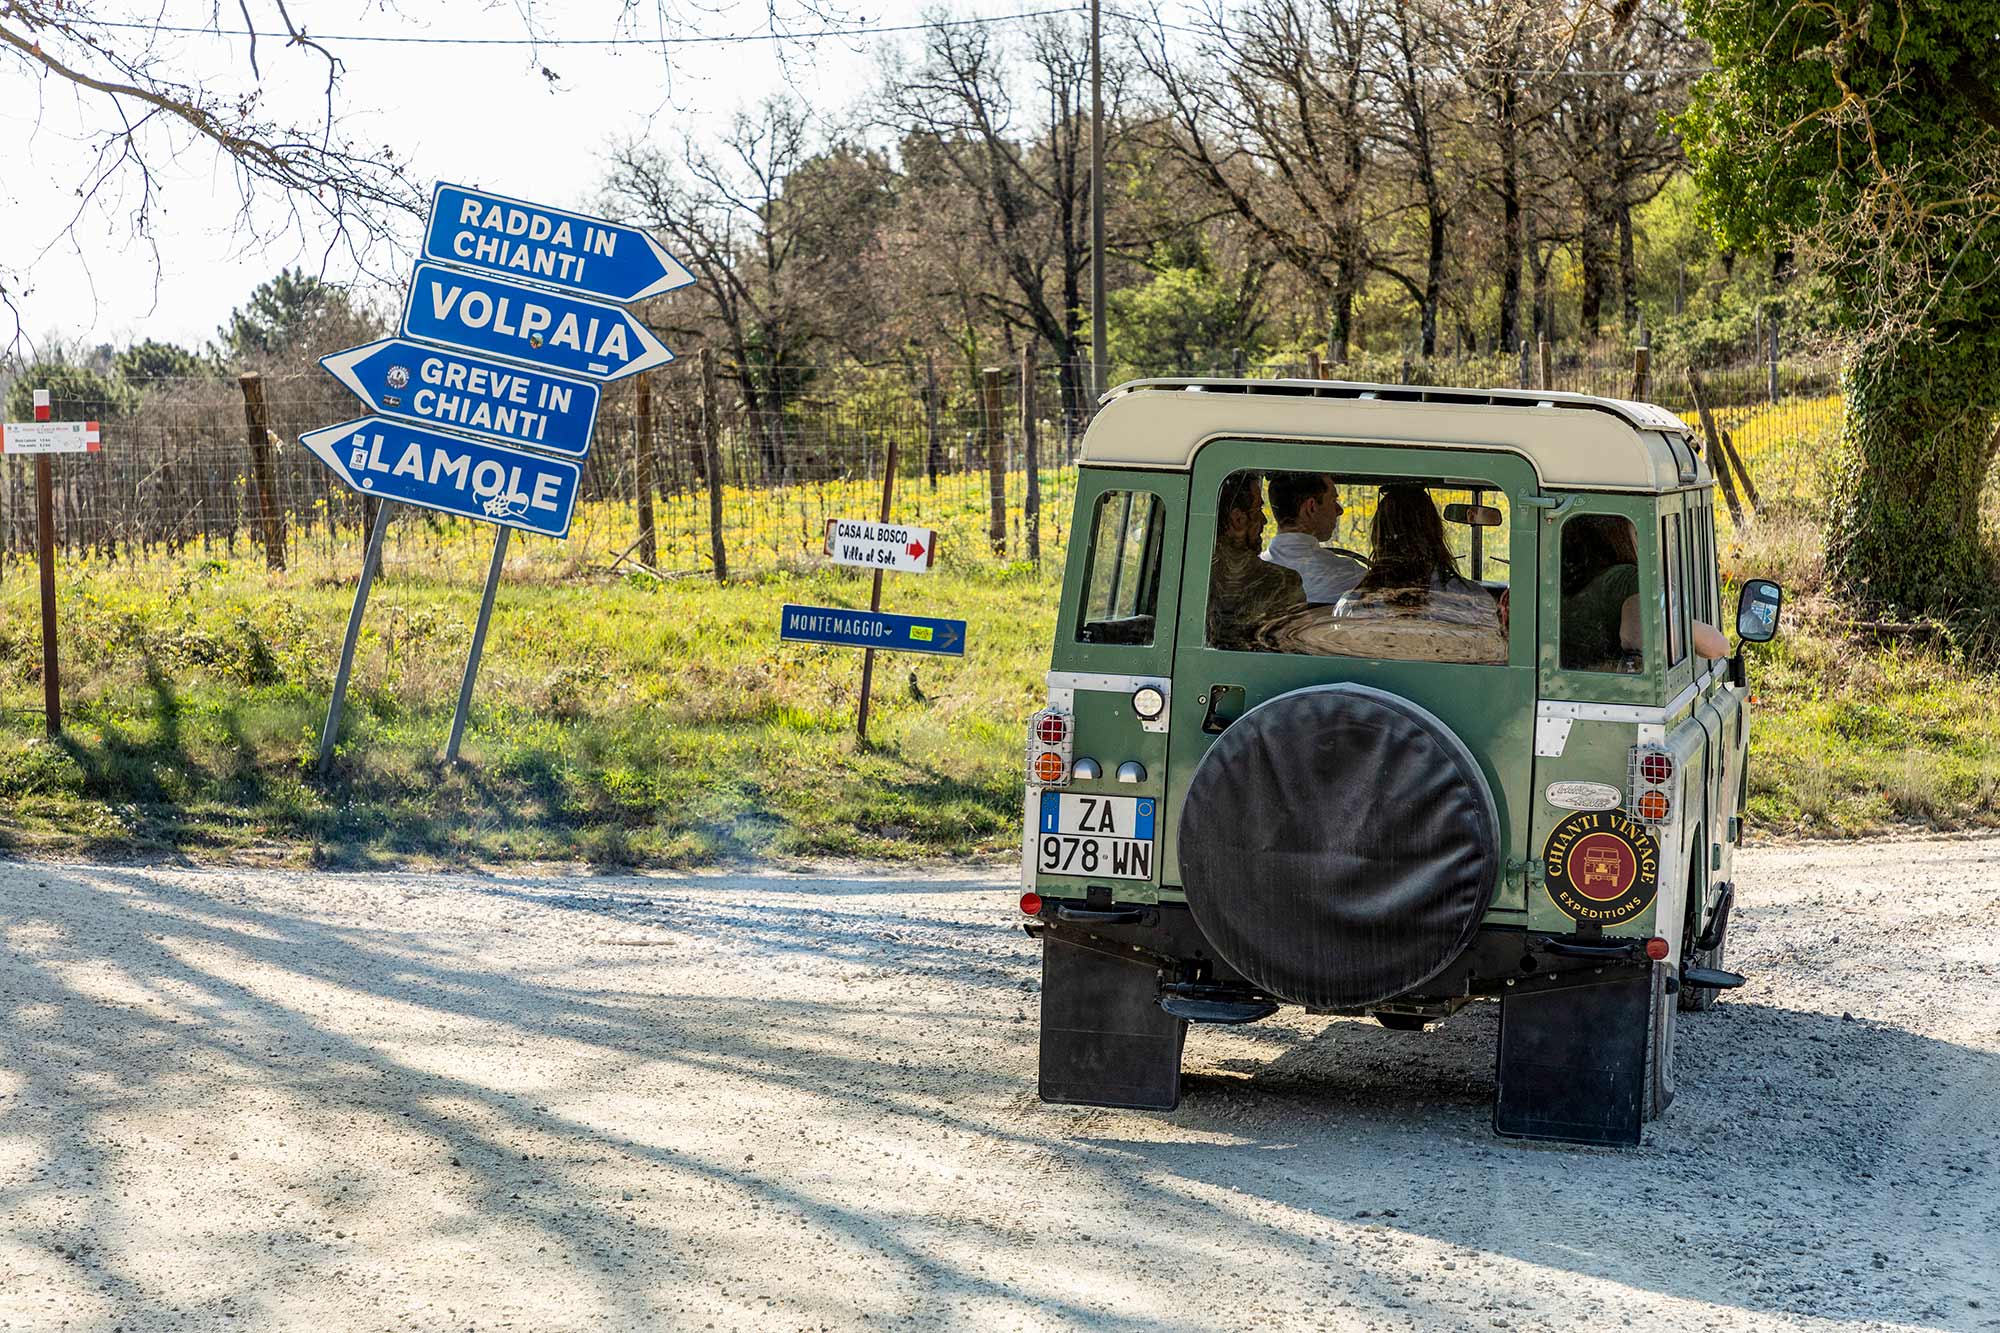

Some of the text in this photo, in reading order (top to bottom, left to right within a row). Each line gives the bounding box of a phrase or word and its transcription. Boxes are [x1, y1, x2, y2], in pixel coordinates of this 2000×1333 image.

[459, 198, 617, 257] RADDA IN
[453, 231, 586, 283] CHIANTI
[431, 281, 630, 362] VOLPAIA
[420, 358, 530, 403] GREVE
[539, 383, 573, 414] IN
[413, 389, 547, 440] CHIANTI
[367, 434, 563, 511] LAMOLE
[838, 523, 908, 544] CASA AL BOSCO
[843, 545, 896, 566] Villa al Sole
[789, 613, 884, 638] MONTEMAGGIO
[1078, 798, 1115, 833] ZA
[1043, 836, 1150, 876] 978 WN
[1548, 814, 1657, 885] CHIANTI VINTAGE
[1559, 891, 1641, 919] EXPEDITIONS
